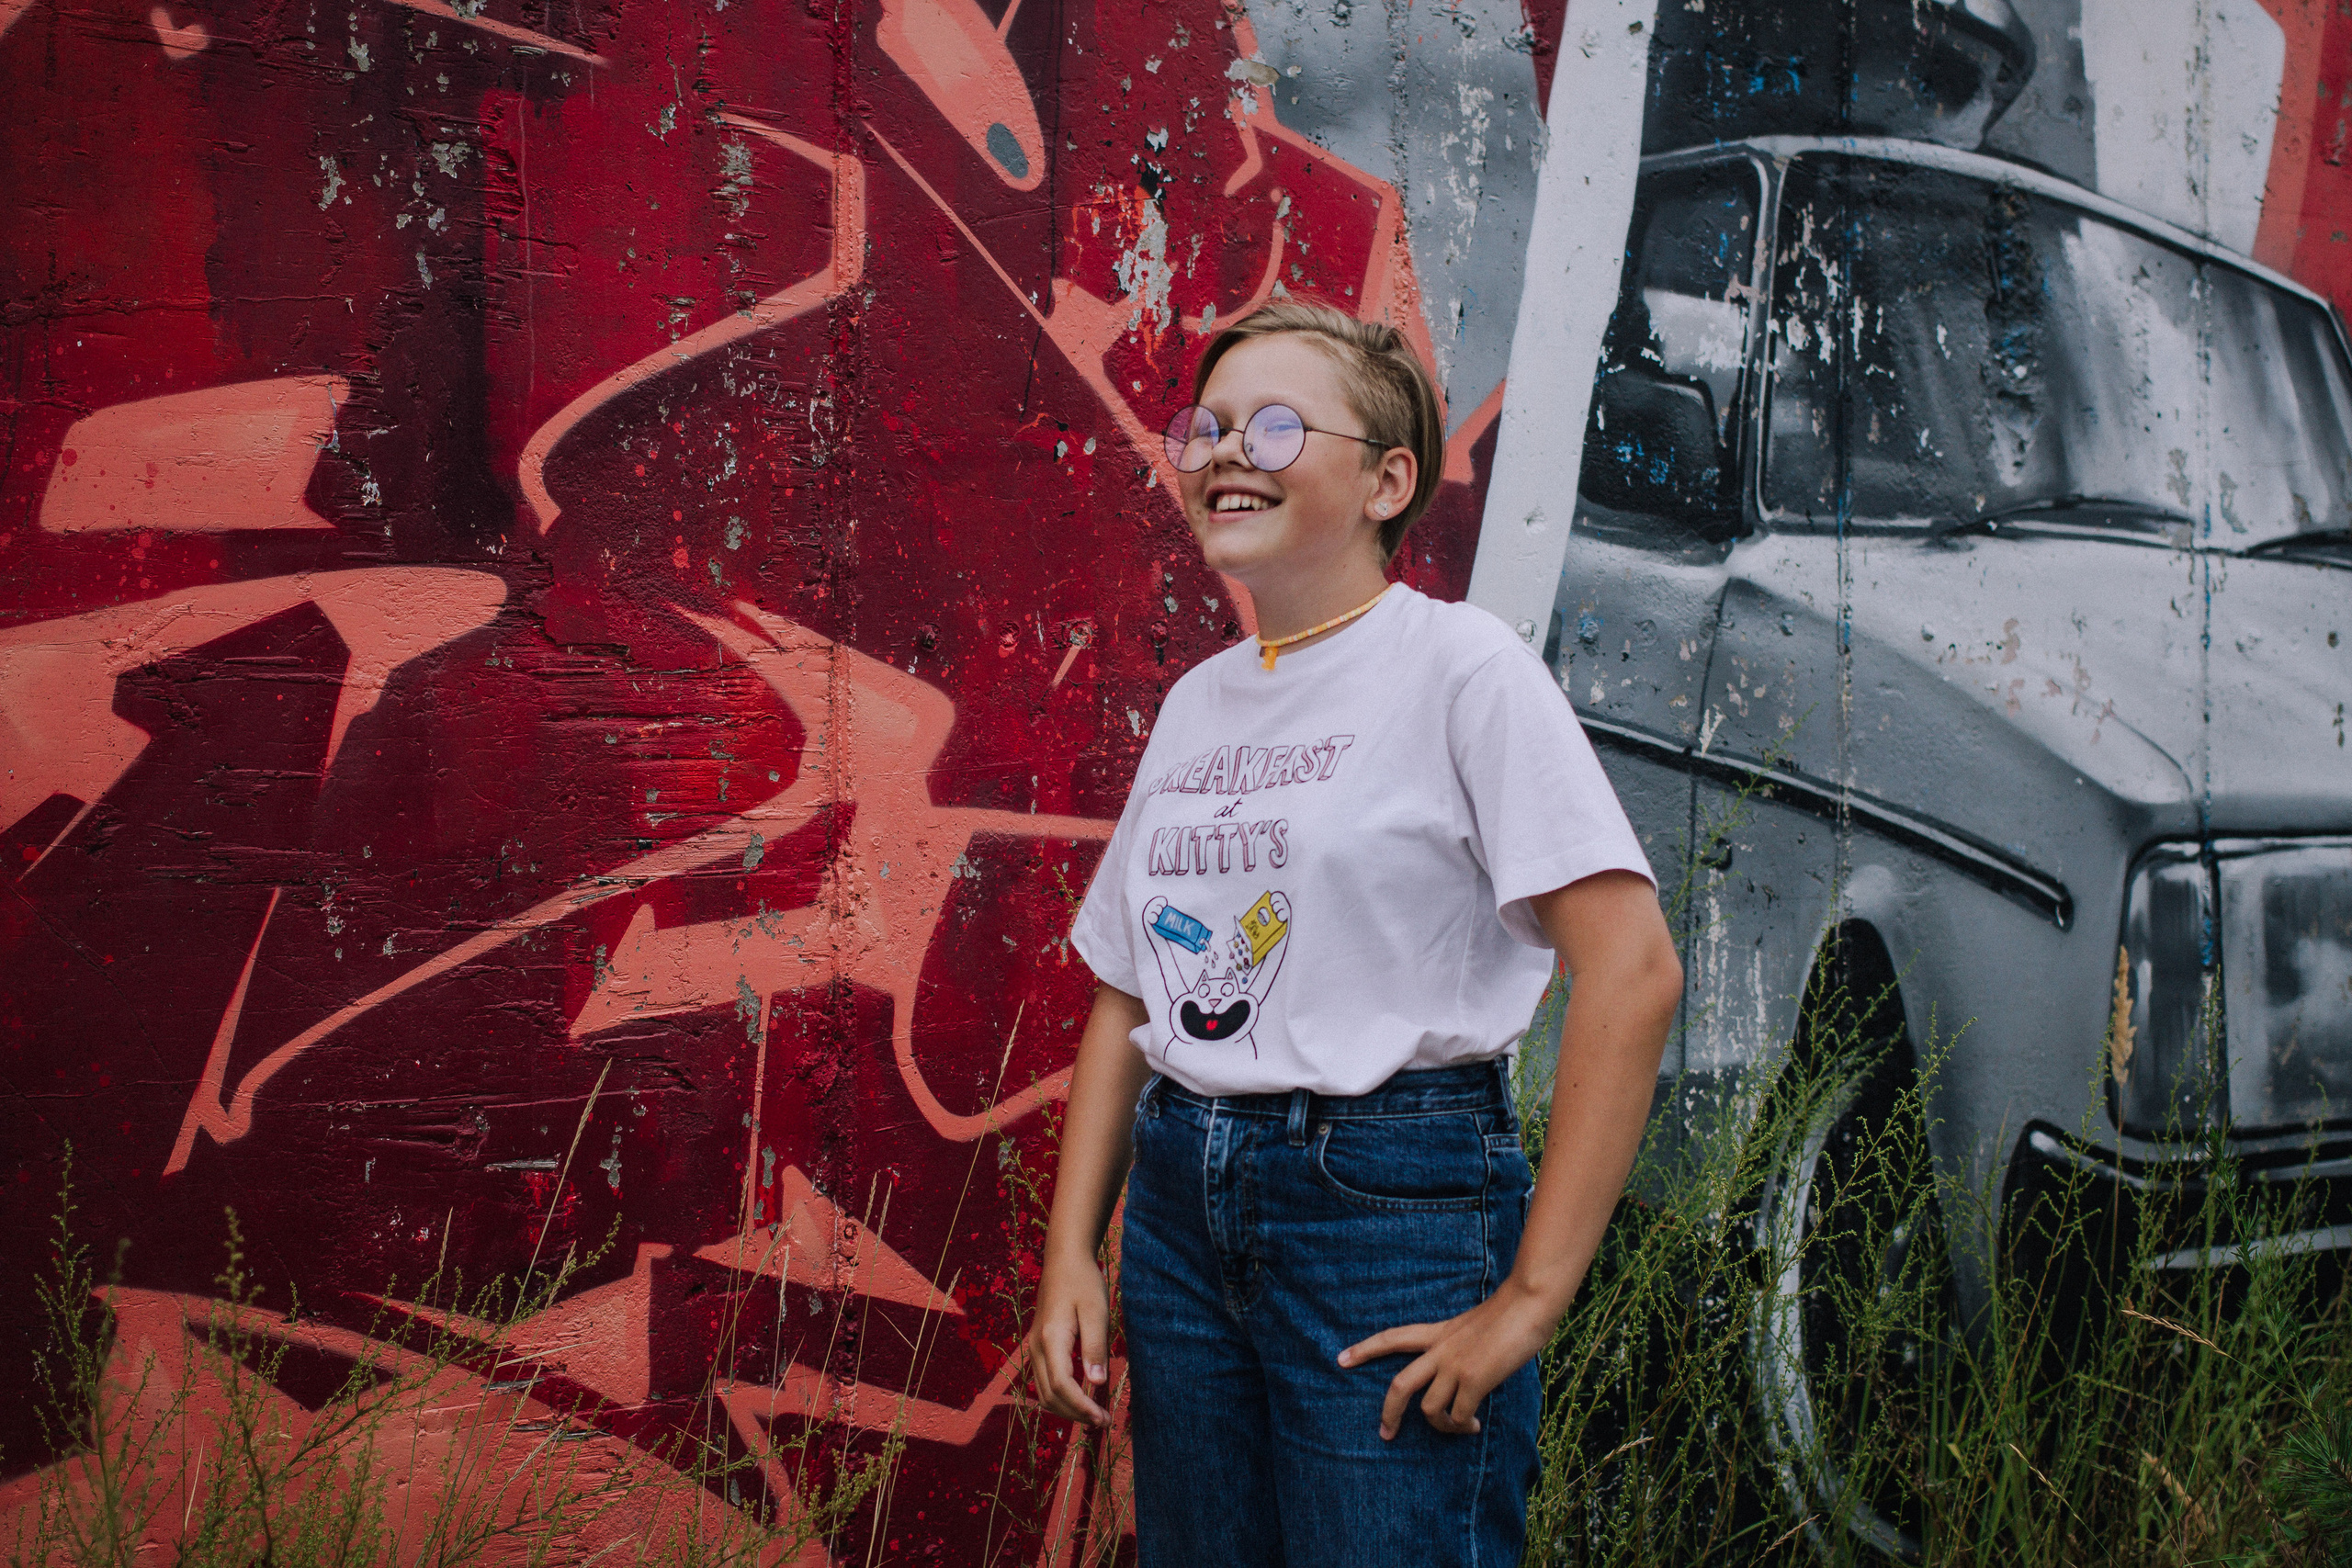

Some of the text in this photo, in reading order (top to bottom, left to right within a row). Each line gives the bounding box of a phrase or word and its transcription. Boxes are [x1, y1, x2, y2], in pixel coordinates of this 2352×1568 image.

[1214, 797, 1243, 818] at
[1148, 818, 1289, 876] KITTY'S
[1164, 911, 1195, 936] MILK
